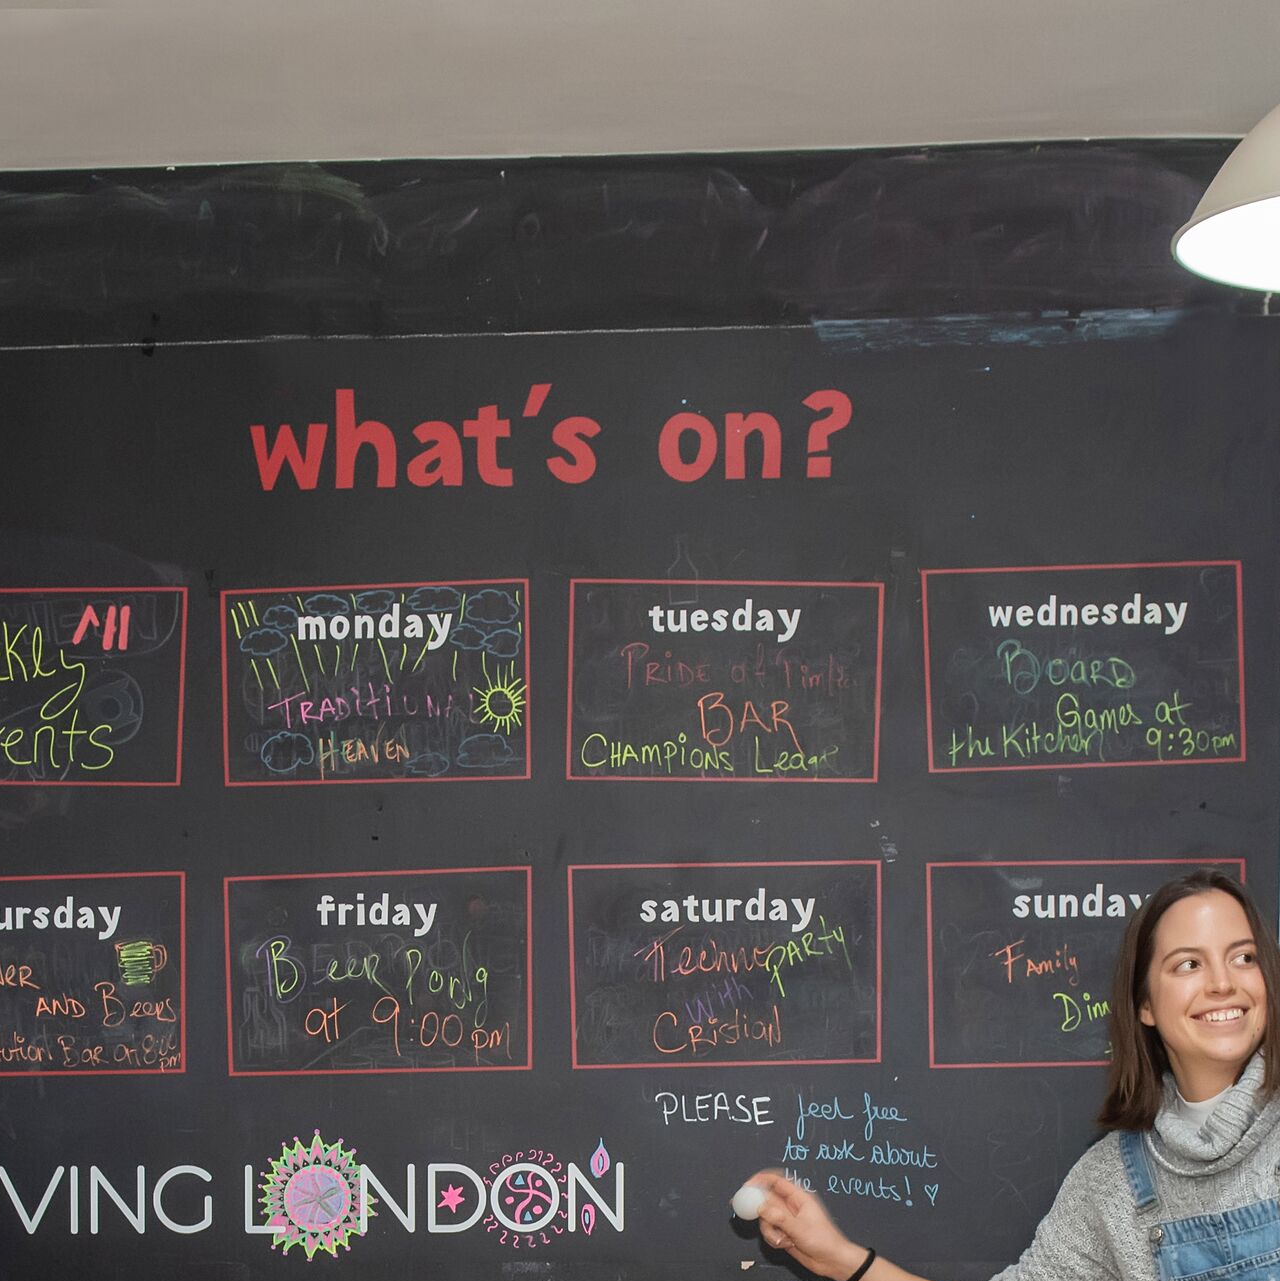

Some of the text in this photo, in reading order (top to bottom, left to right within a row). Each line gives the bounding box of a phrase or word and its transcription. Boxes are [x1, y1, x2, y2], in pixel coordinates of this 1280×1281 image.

[250, 383, 853, 490] what's on?
[297, 603, 453, 650] monday
[648, 599, 801, 643] tuesday
[988, 593, 1188, 635] wednesday
[697, 692, 805, 755] BAR
[1155, 689, 1193, 726] at
[316, 893, 437, 937] friday
[640, 888, 815, 932] saturday
[36, 992, 86, 1018] AND
[305, 997, 352, 1043] at
[655, 1092, 907, 1141] PLEASE feel free
[782, 1136, 938, 1168] to ask about
[244, 1161, 625, 1235] LONDON
[828, 1175, 913, 1207] events!
